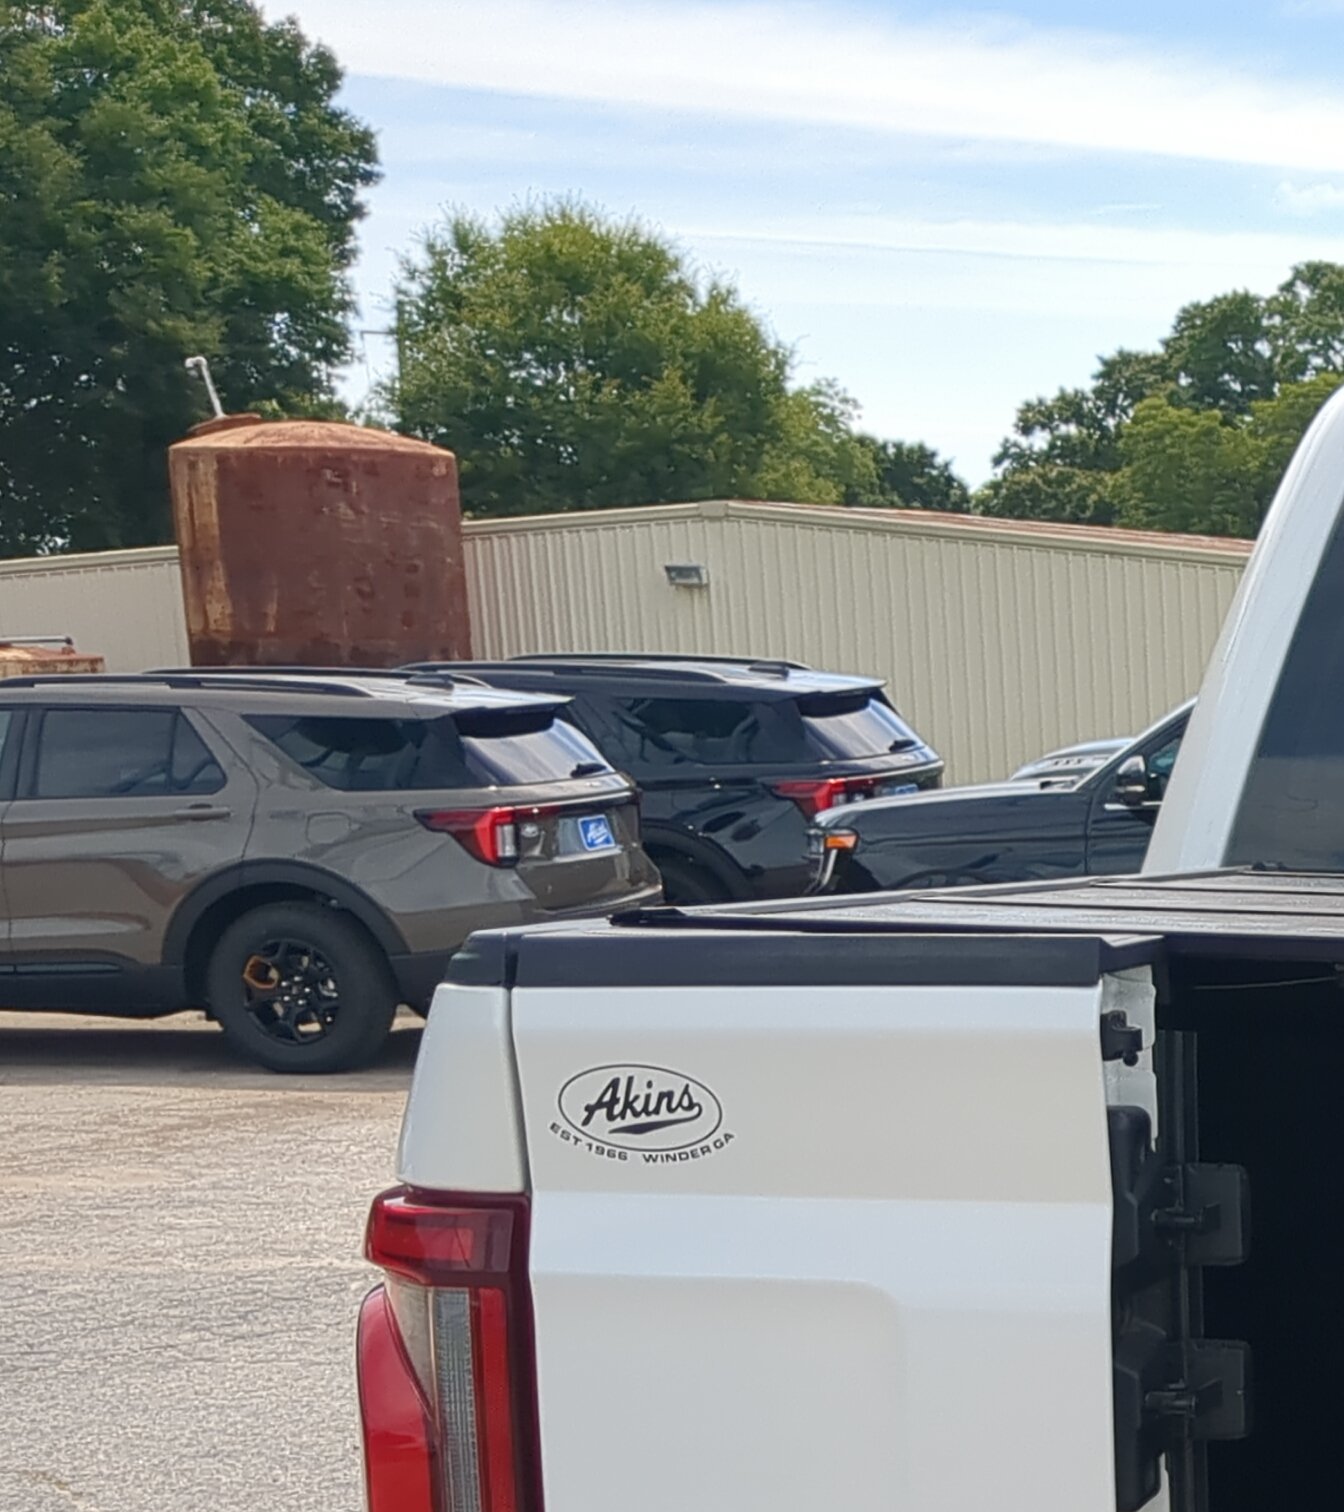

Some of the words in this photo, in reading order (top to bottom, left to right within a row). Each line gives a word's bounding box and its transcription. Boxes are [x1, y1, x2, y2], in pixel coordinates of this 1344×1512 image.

[581, 1075, 703, 1134] Akins
[549, 1121, 582, 1146] EST
[586, 1142, 628, 1161] 1966
[642, 1145, 712, 1163] WINDER
[713, 1132, 735, 1149] GA
